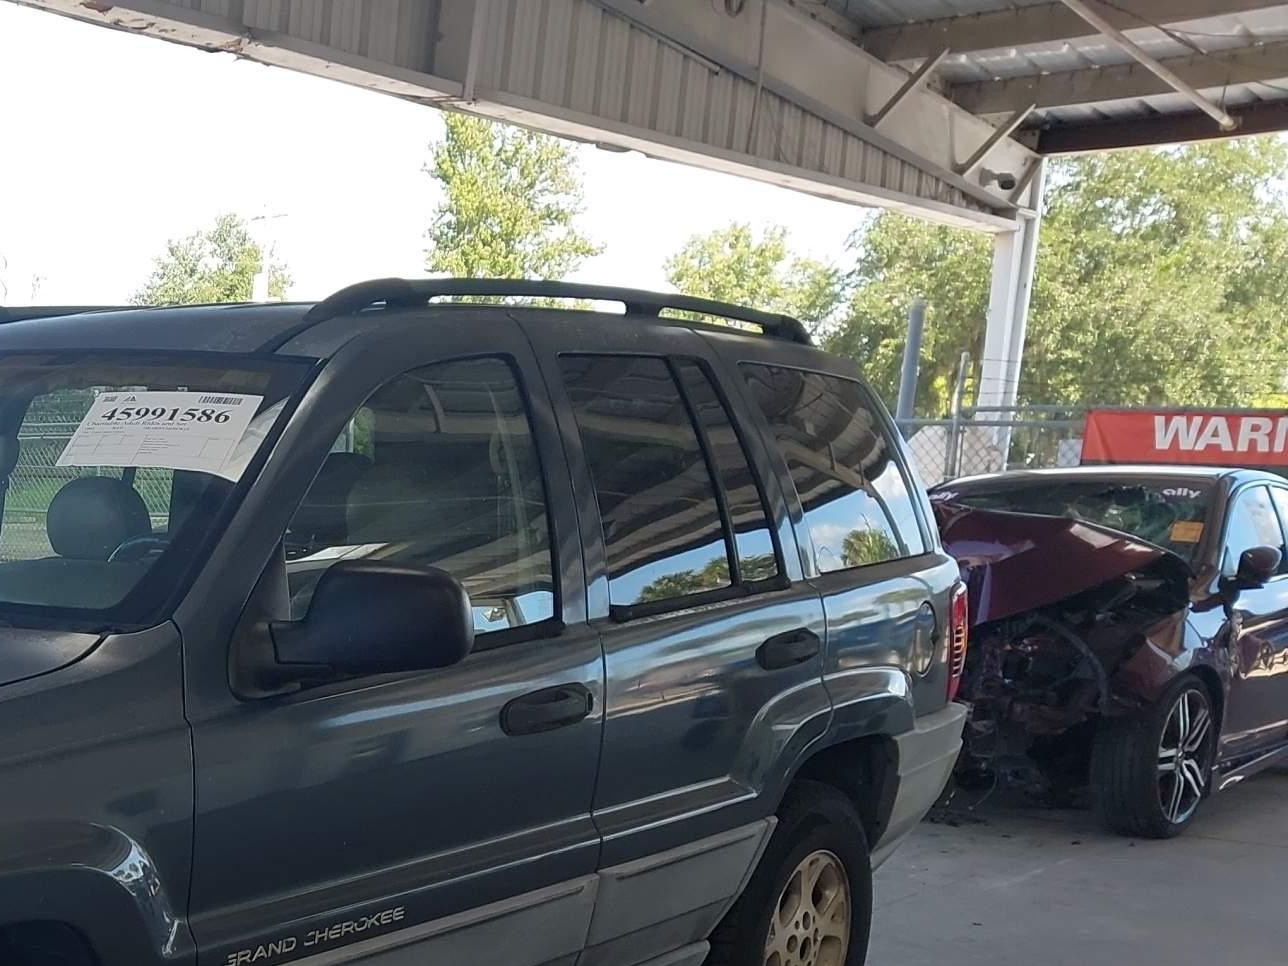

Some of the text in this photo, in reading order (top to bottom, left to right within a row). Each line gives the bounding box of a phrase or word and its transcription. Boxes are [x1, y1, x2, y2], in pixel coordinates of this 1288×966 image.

[101, 407, 232, 424] 45991586
[1162, 487, 1201, 498] ally
[304, 906, 405, 947] CHEROKEE
